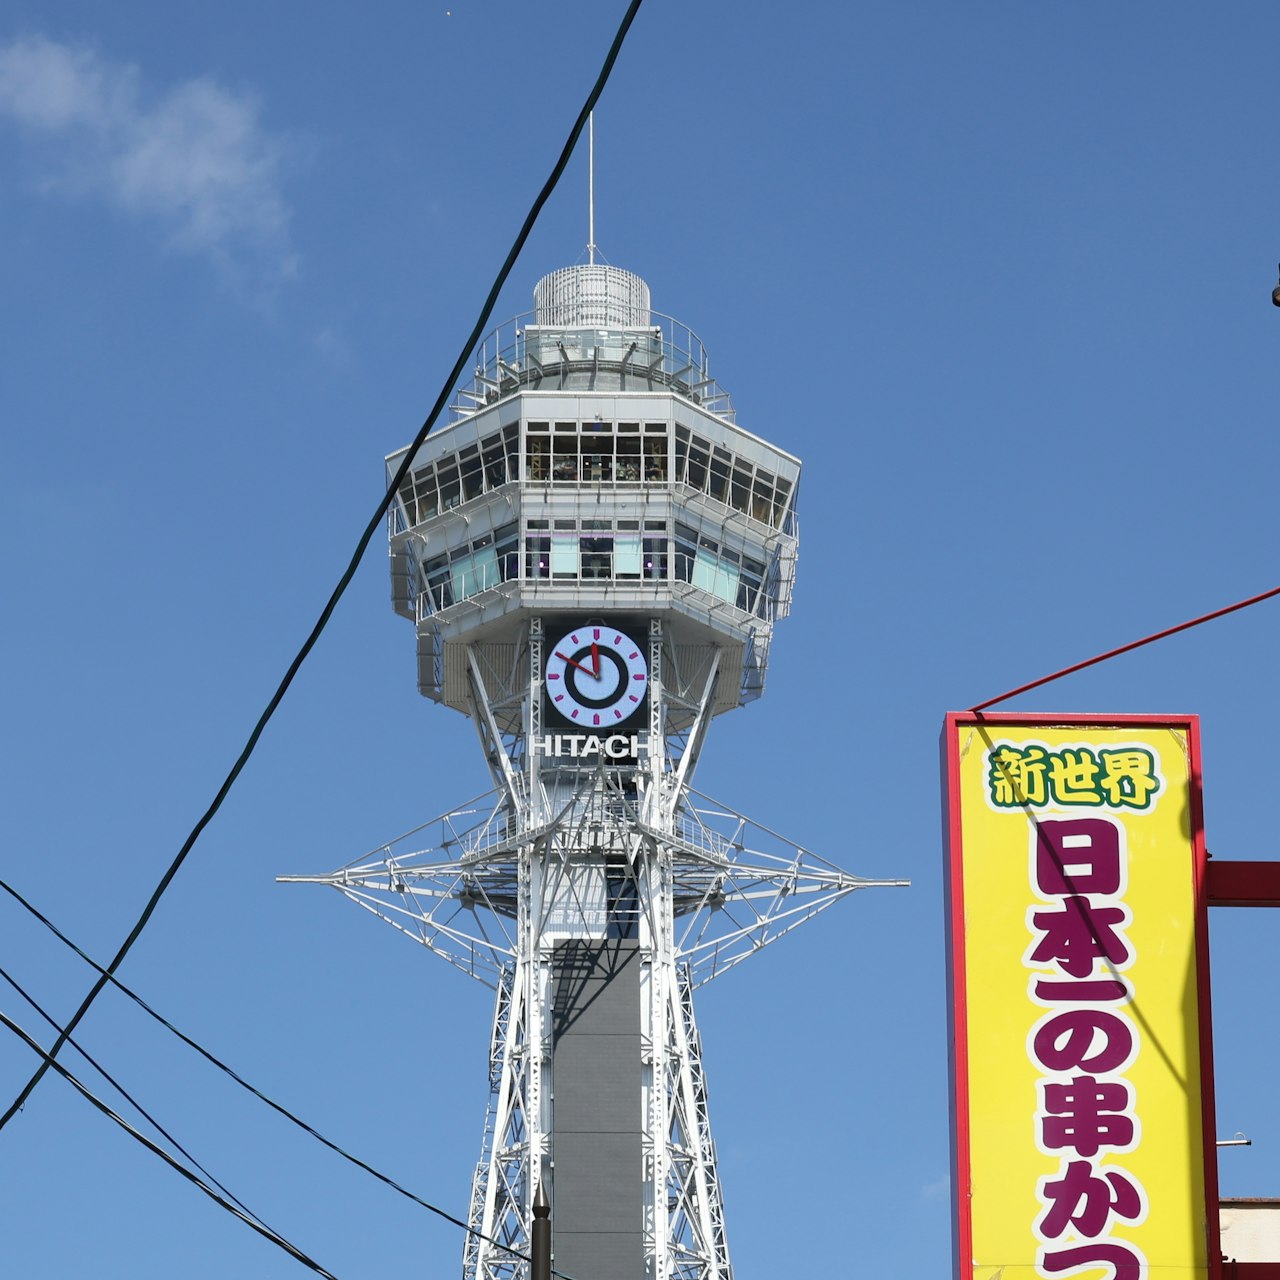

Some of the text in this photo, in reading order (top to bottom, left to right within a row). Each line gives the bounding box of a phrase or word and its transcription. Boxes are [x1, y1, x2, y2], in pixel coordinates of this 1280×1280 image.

[528, 735, 665, 758] HITACHI
[991, 747, 1158, 808] 新世界
